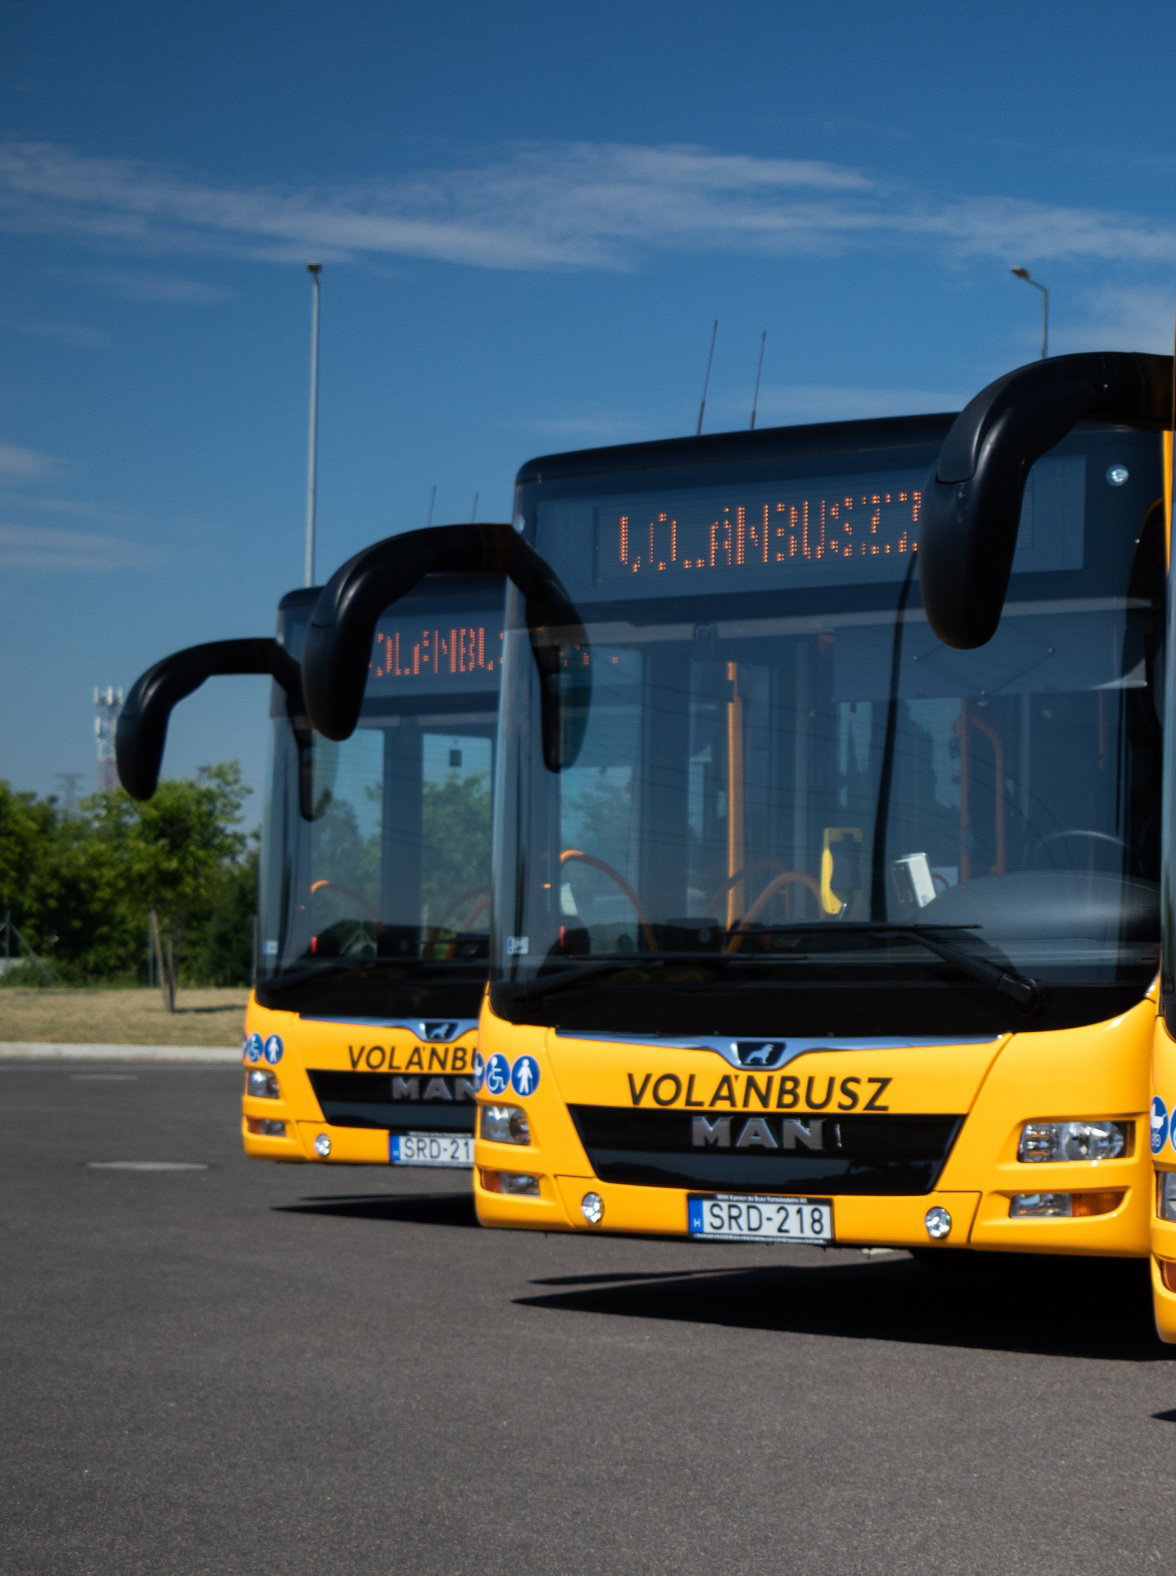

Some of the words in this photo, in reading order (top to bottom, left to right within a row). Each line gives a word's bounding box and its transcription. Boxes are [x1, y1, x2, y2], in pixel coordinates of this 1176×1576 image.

[627, 1073, 894, 1112] VOLÁNBUSZ
[404, 1137, 471, 1160] SRD-21
[692, 1115, 828, 1151] MAN
[709, 1202, 824, 1235] SRD-218
